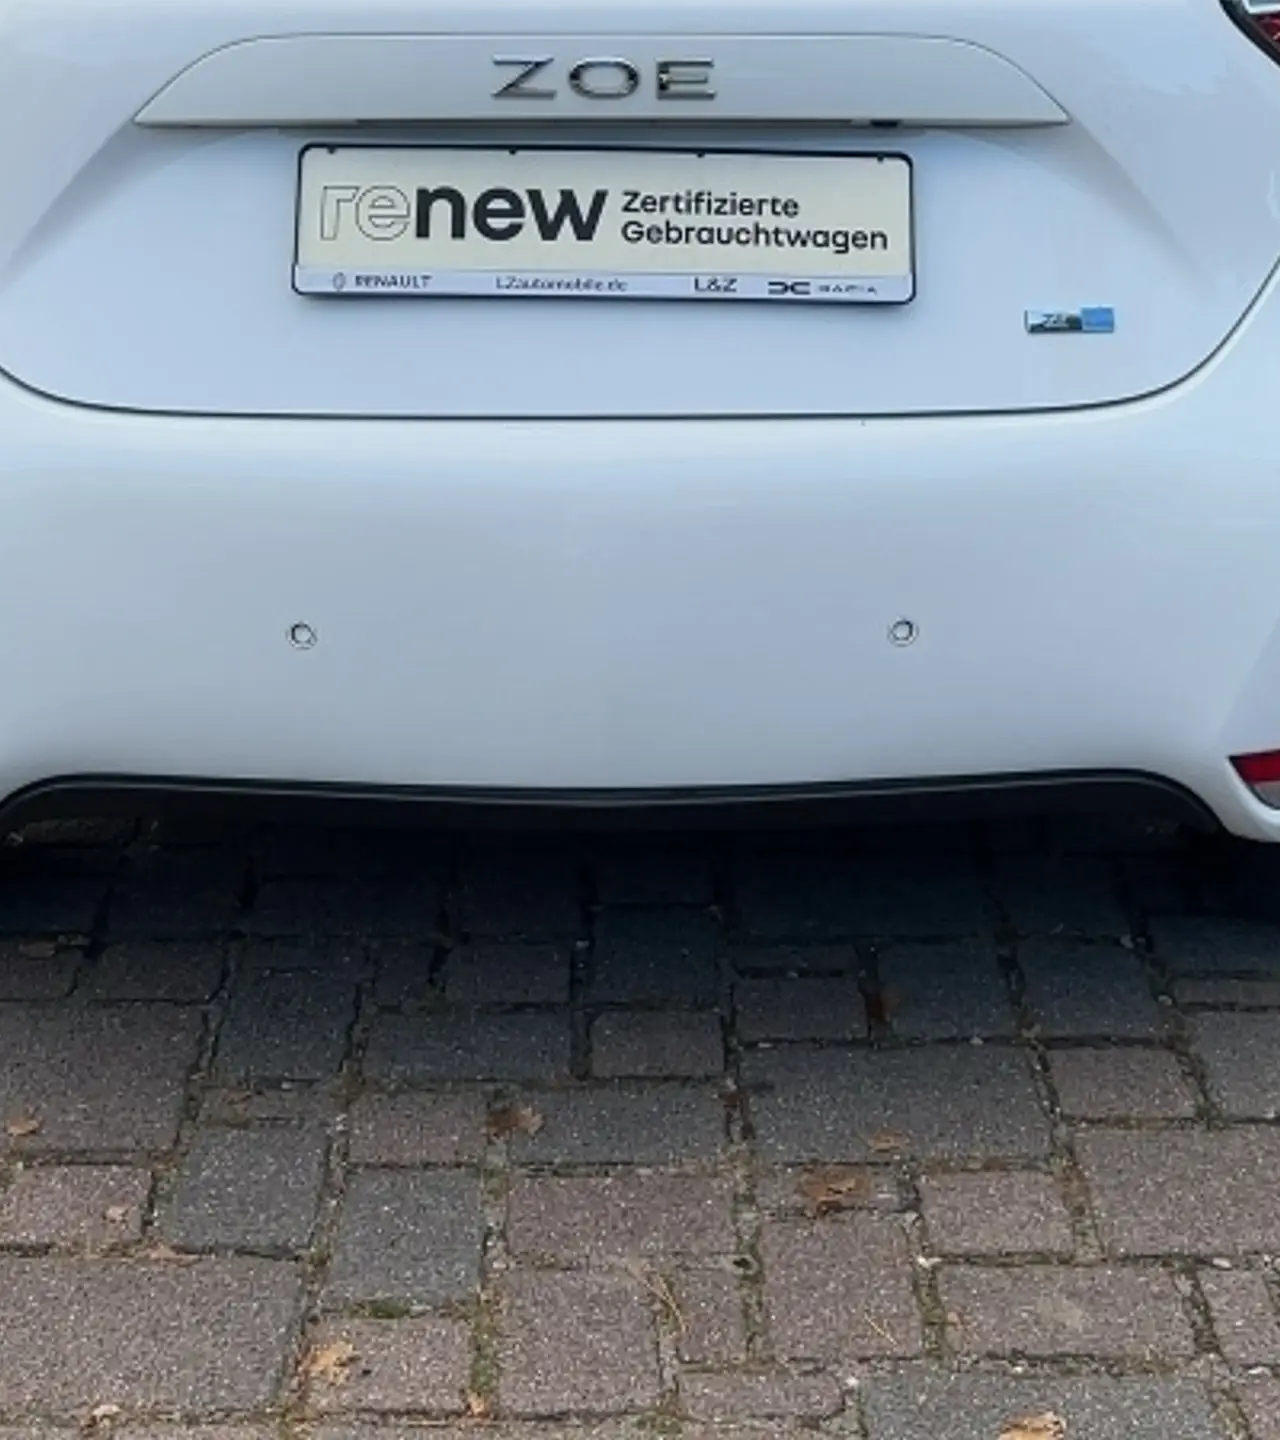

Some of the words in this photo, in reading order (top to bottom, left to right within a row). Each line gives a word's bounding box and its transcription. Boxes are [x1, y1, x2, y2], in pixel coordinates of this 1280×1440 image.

[490, 54, 718, 101] ZOE
[320, 185, 609, 242] renew
[620, 190, 800, 218] Zertifizierte
[620, 220, 888, 254] Gebrauchtwagen
[354, 274, 433, 289] RENAULT
[693, 277, 738, 293] L&Z
